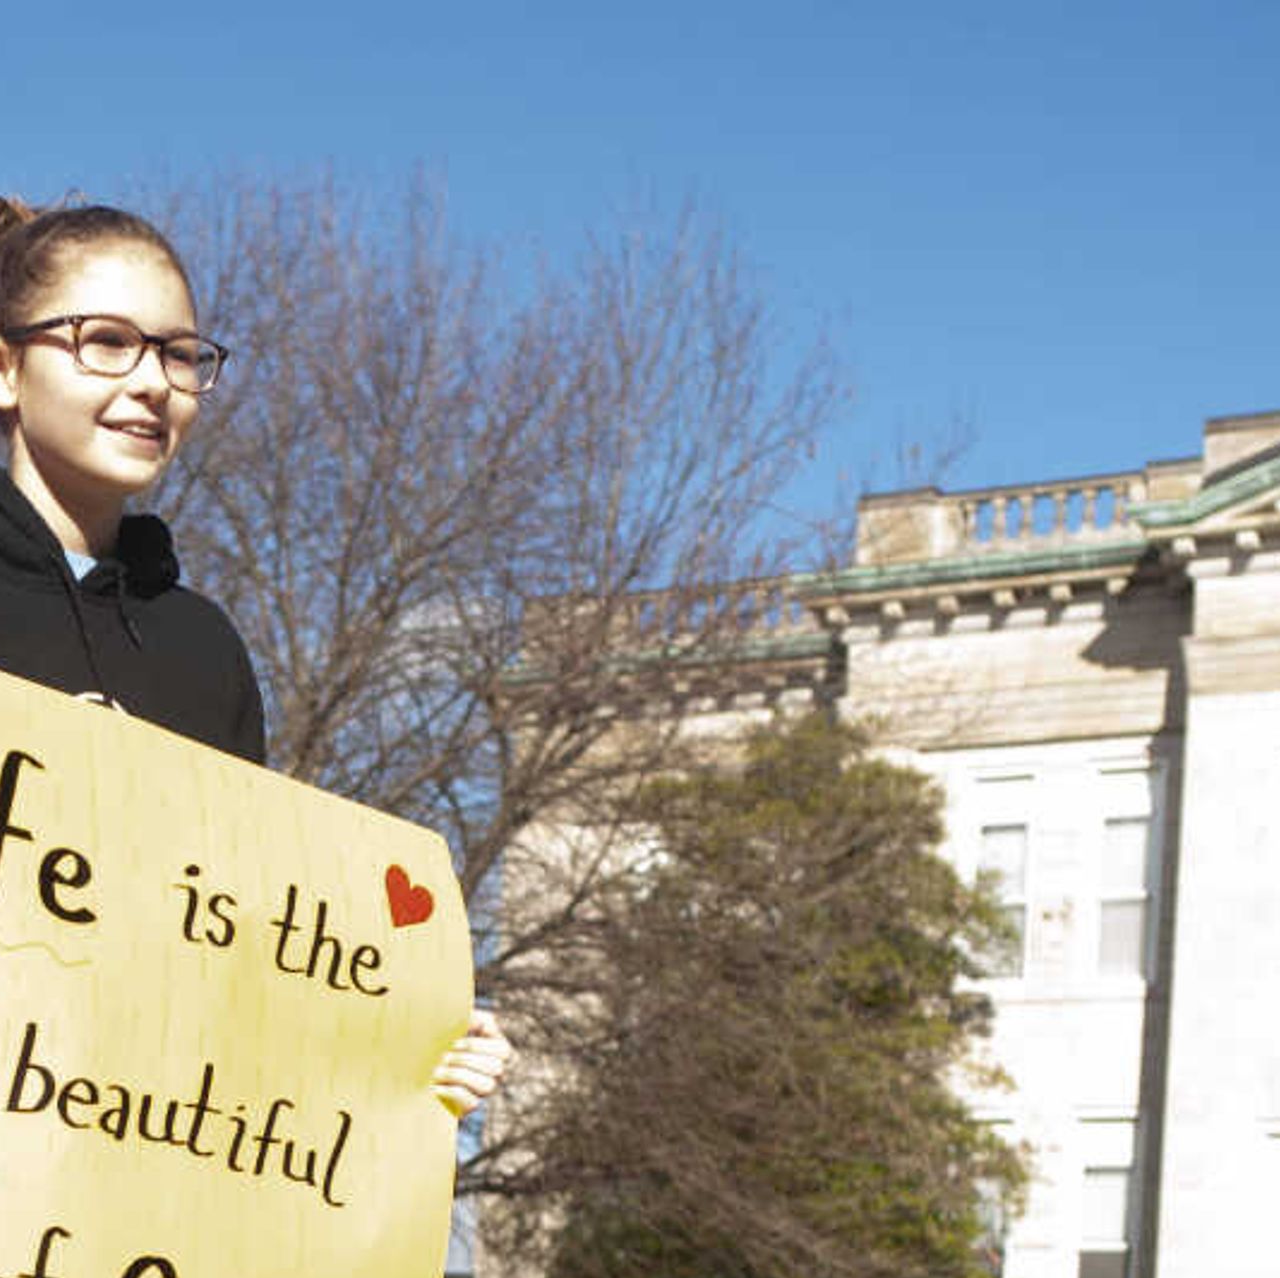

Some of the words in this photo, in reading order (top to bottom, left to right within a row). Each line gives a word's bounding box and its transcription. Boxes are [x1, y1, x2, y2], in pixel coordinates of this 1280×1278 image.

[175, 863, 237, 948] is
[271, 884, 389, 997] the
[6, 1022, 352, 1206] beautiful
